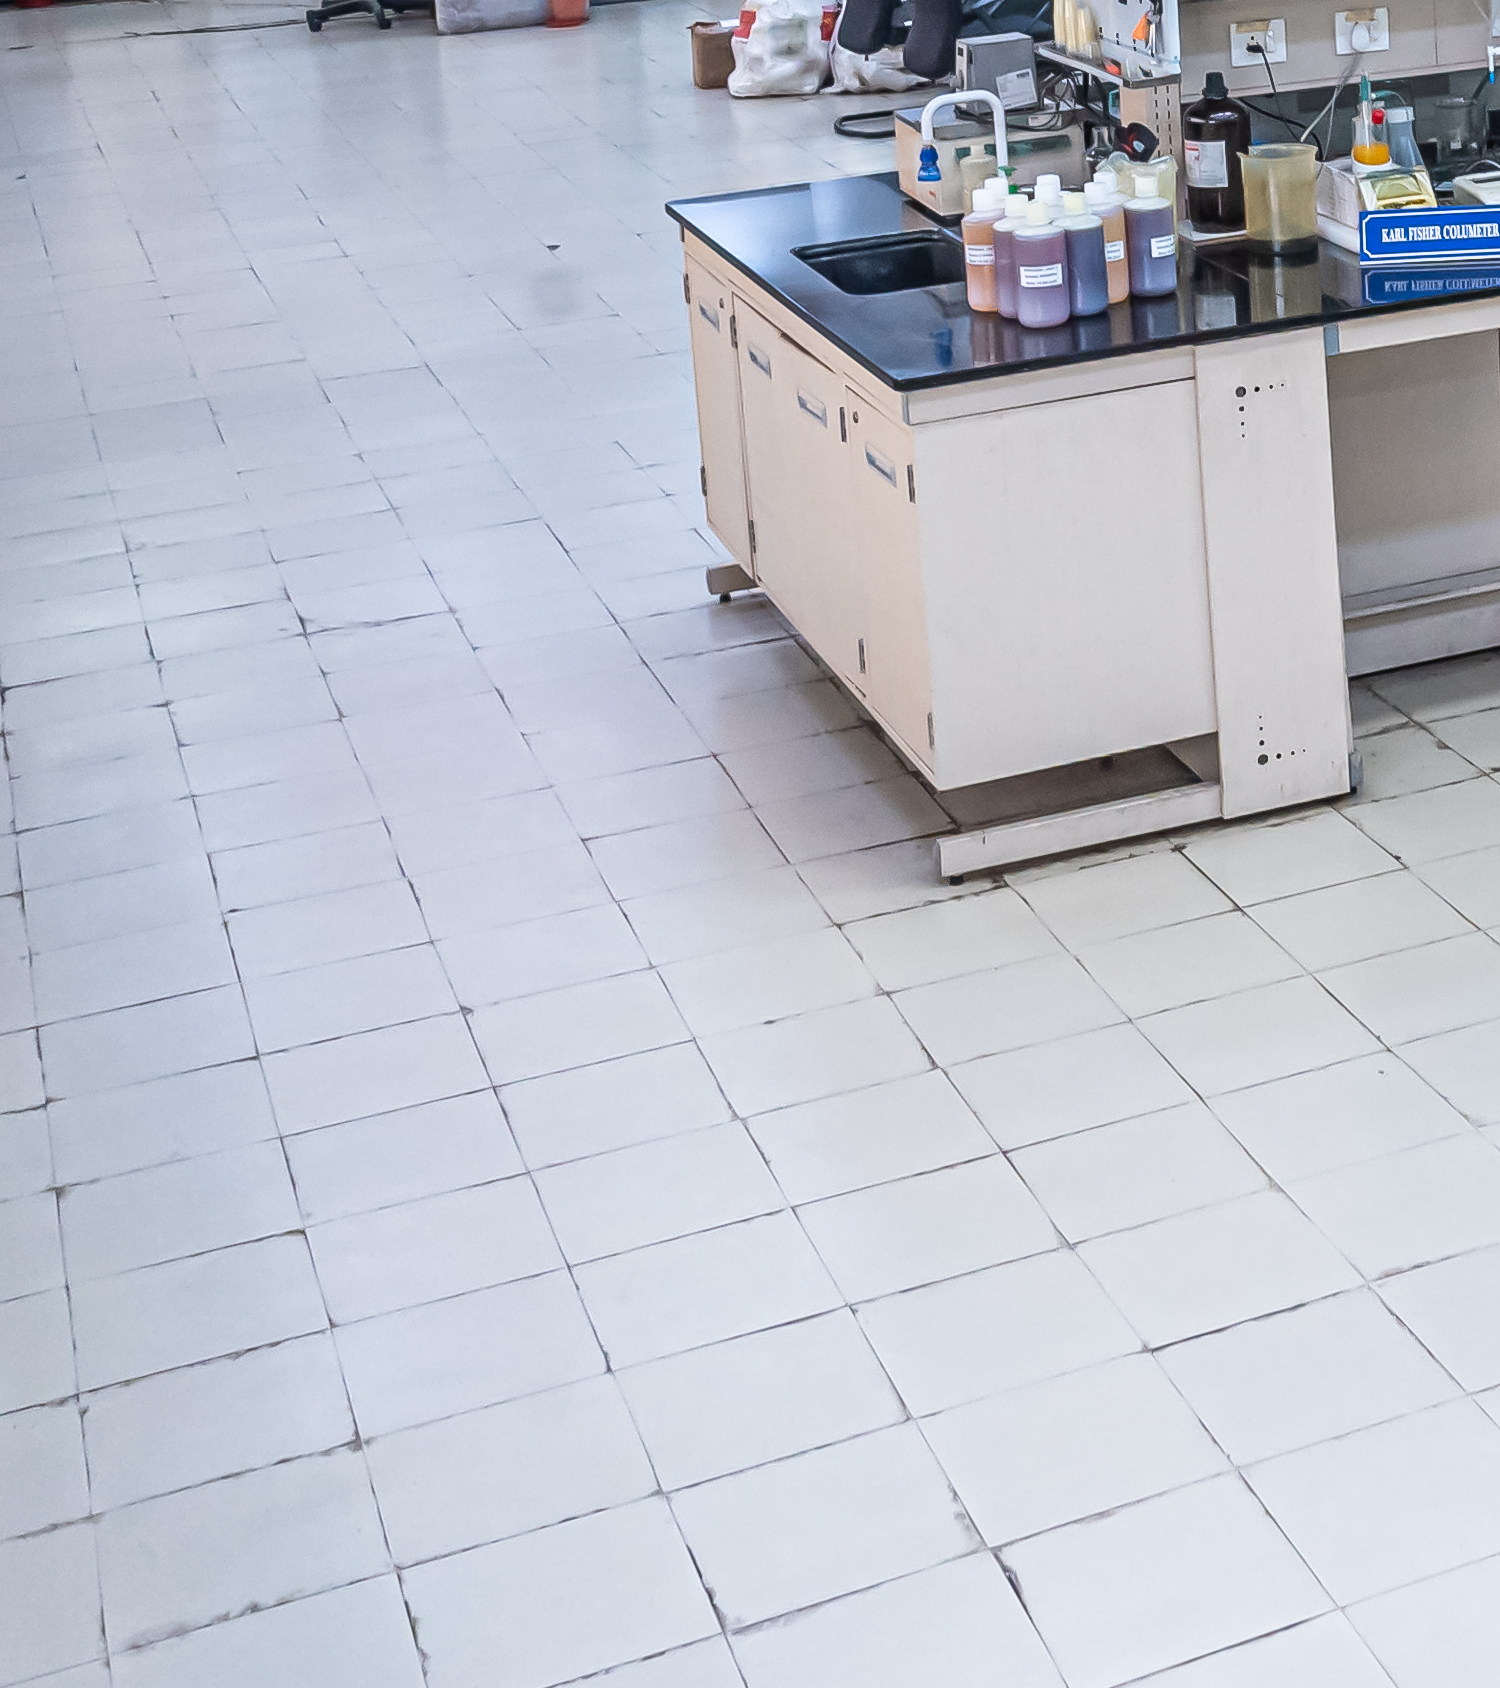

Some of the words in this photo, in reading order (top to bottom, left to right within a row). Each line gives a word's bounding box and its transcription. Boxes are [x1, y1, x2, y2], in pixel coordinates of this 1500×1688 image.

[1381, 228, 1407, 243] KARL
[1408, 225, 1443, 241] FISHER
[1443, 222, 1500, 239] COLUMETER
